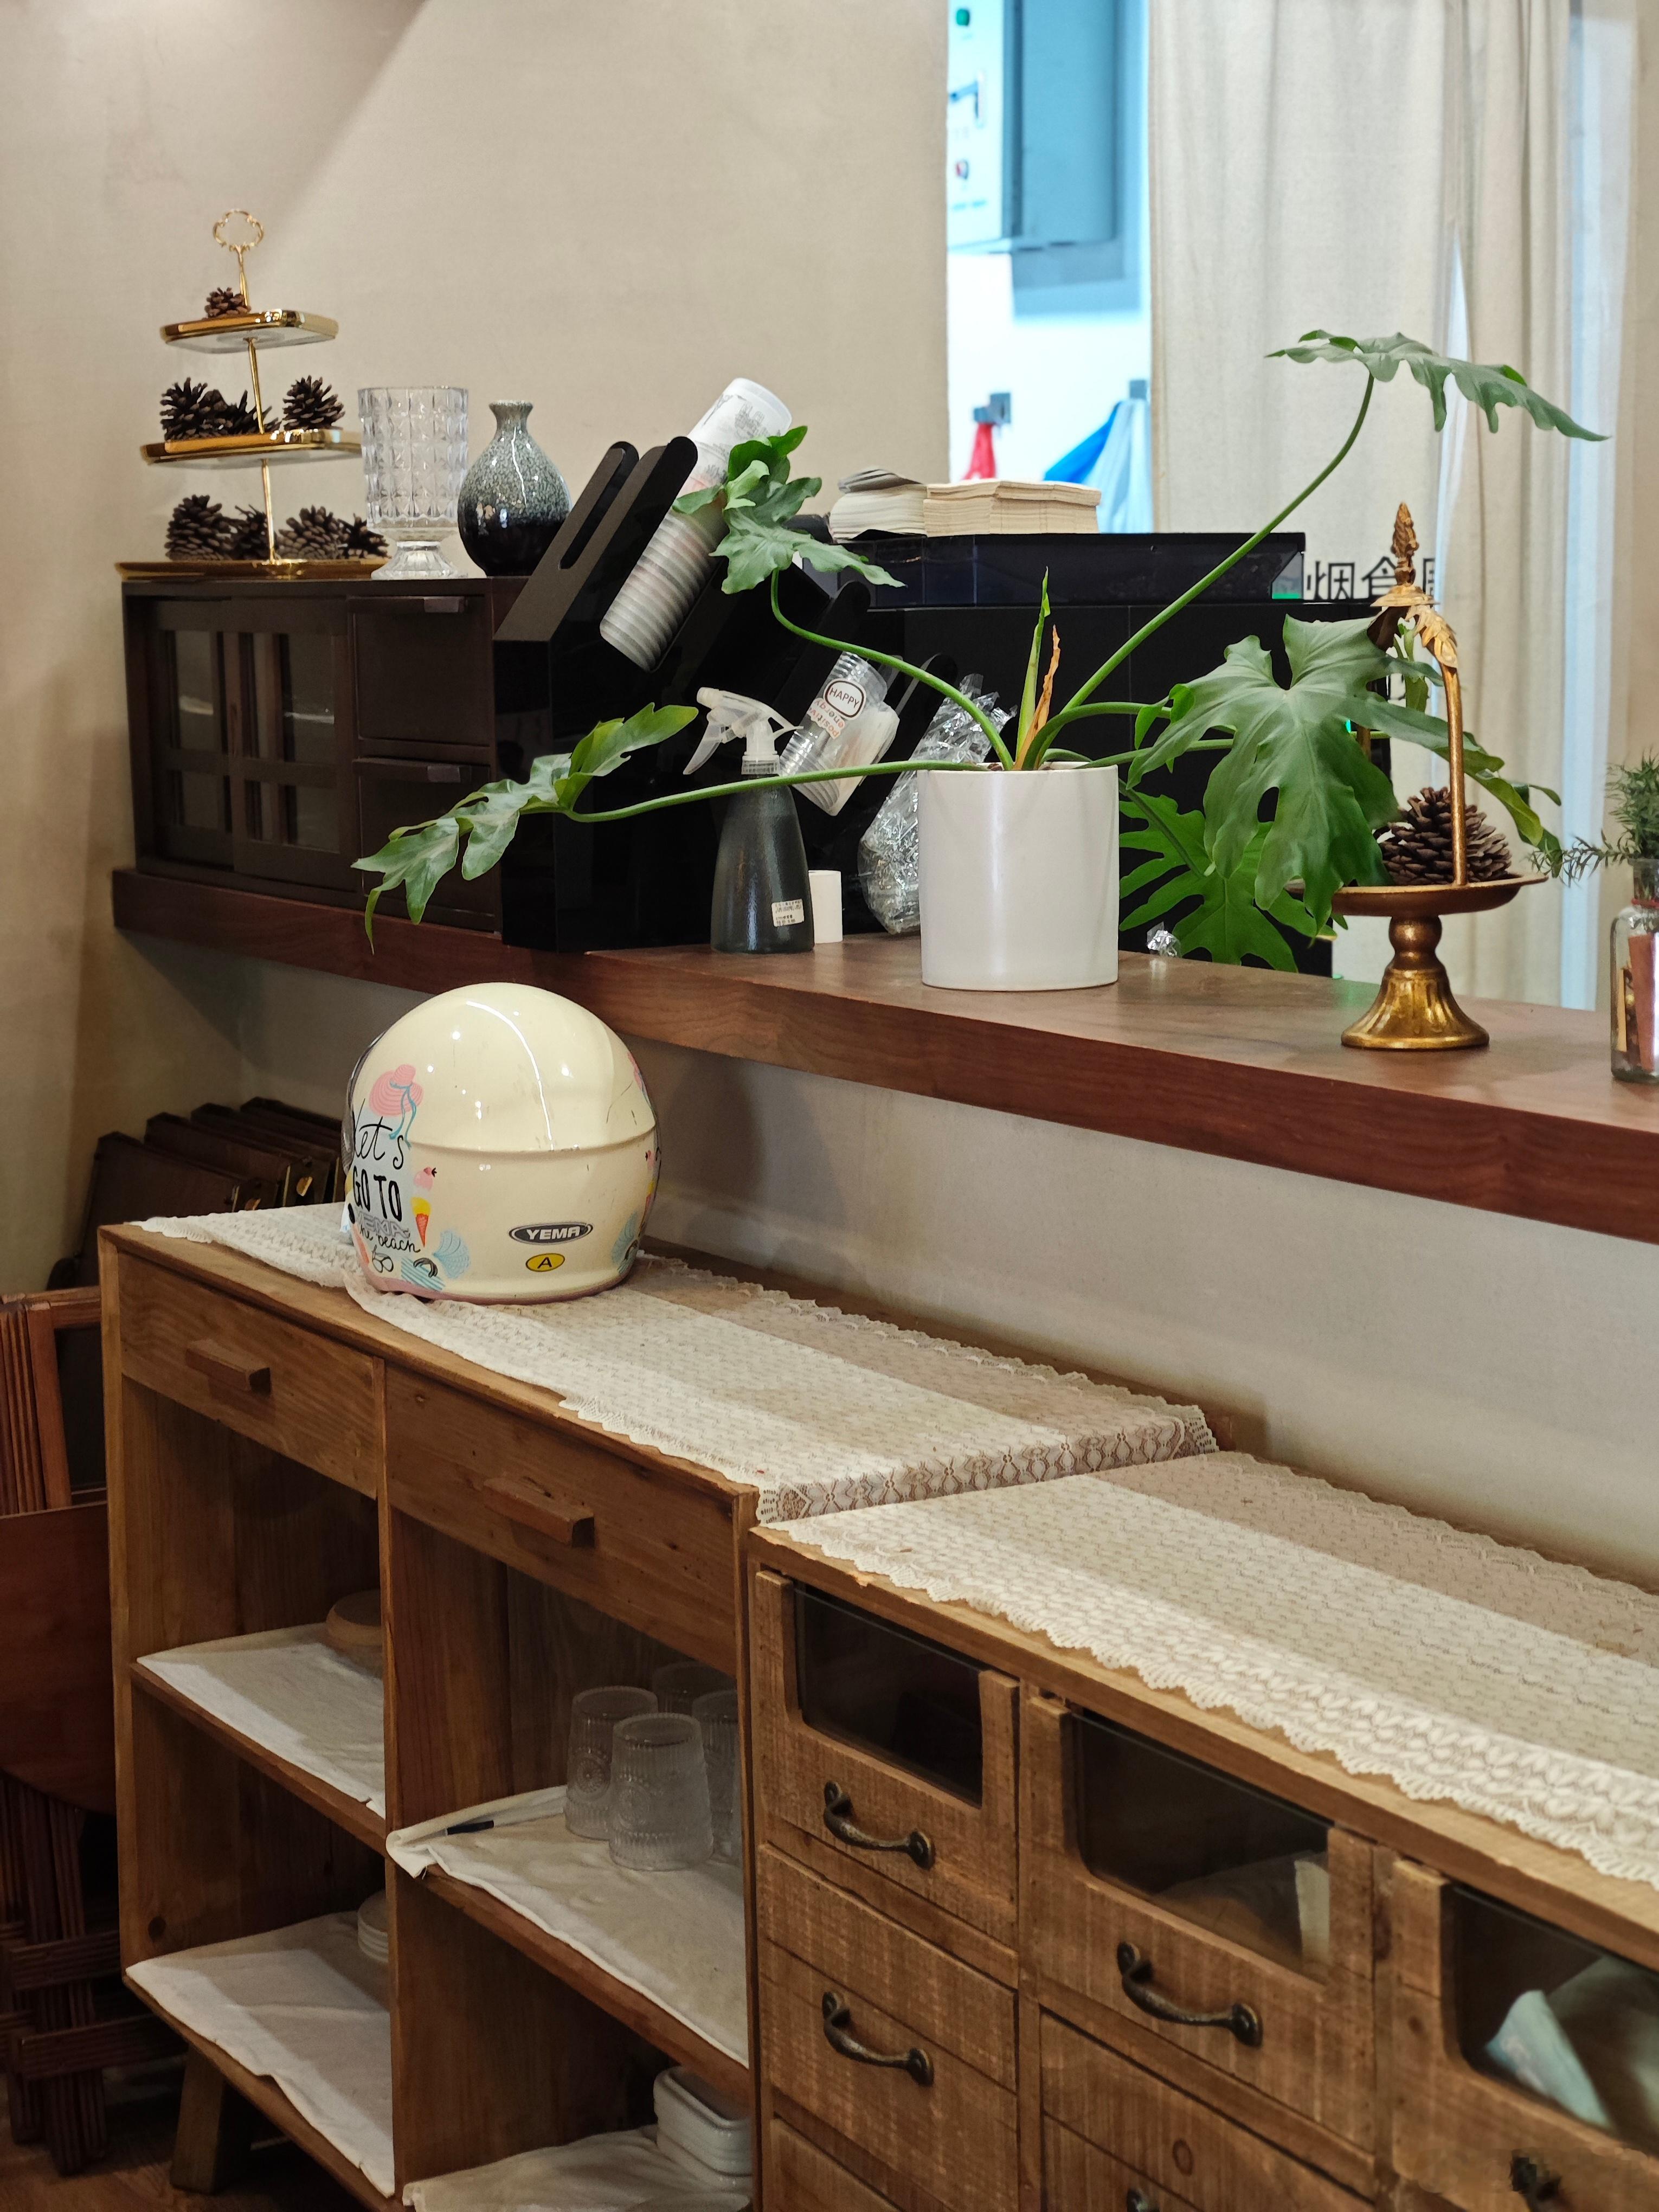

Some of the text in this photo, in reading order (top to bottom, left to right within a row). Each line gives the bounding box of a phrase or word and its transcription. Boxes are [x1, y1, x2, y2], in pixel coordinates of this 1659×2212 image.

[829, 687, 859, 709] HAPPY
[352, 1165, 402, 1222] GO TO
[526, 1226, 581, 1240] YEMA
[537, 1257, 552, 1269] A
